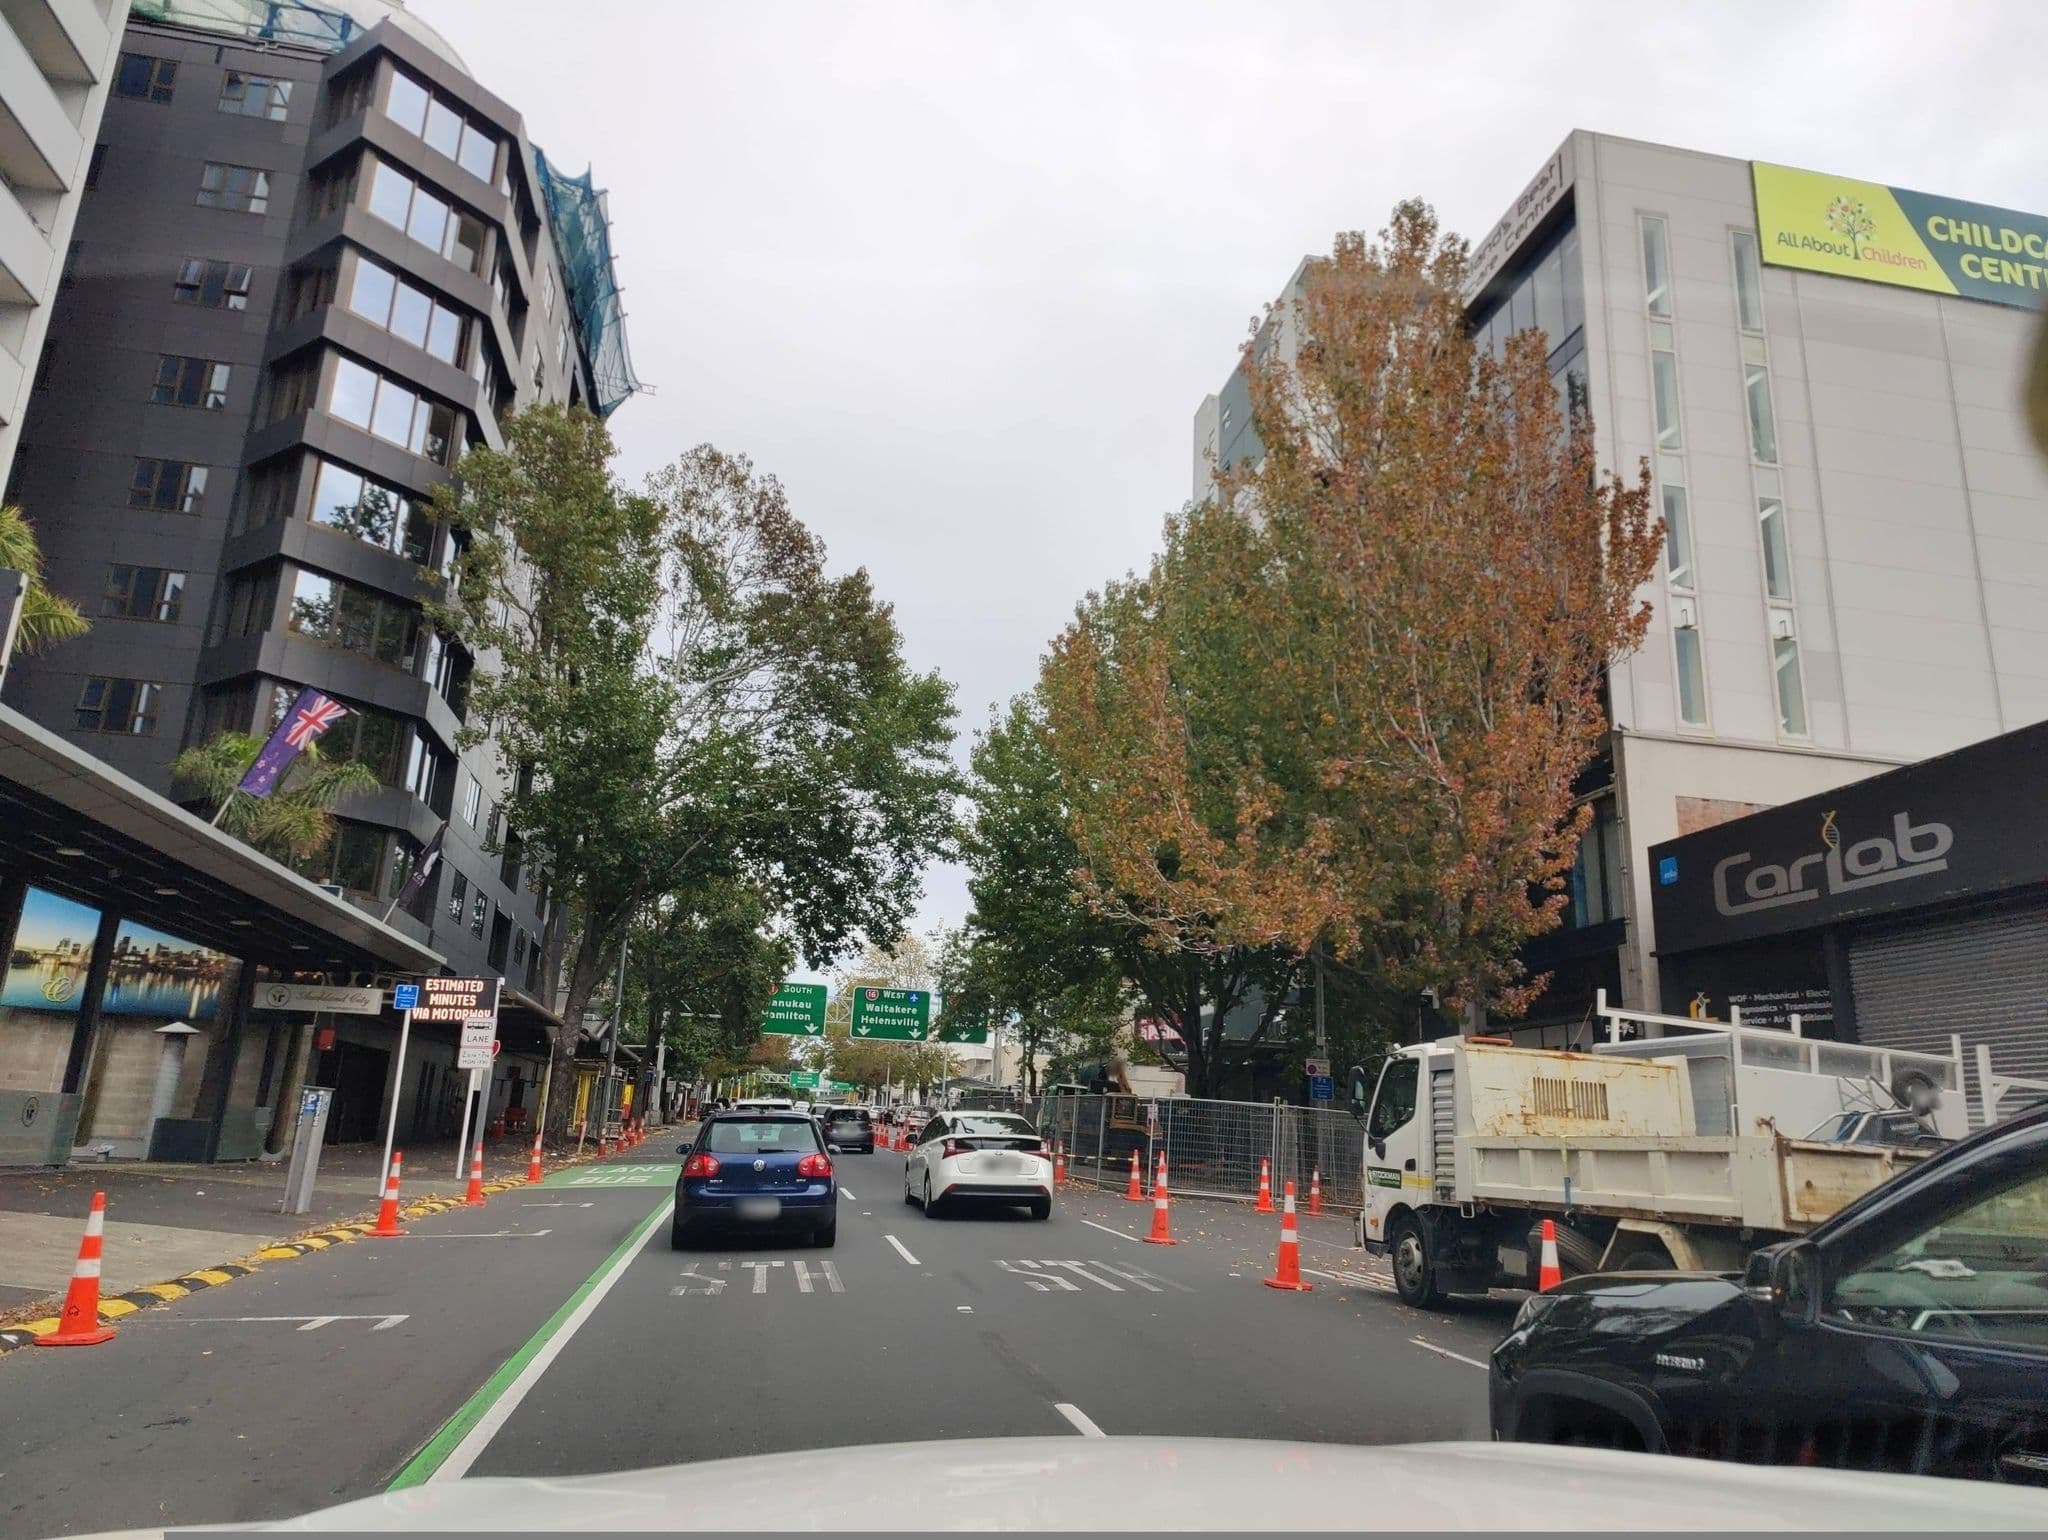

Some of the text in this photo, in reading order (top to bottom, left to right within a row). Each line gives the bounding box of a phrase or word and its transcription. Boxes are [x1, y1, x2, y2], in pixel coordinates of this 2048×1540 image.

[1504, 185, 1556, 252] Centre
[1777, 231, 1928, 270] All About Children
[425, 979, 484, 992] ESTIMATED
[429, 993, 477, 1006] MINUTES
[883, 990, 906, 999] WEST
[1728, 995, 1747, 1003] WOF
[1753, 991, 1799, 1002] Mechanical
[767, 1000, 812, 1009] anukau
[866, 1003, 917, 1015] Waitakere
[1739, 1004, 1778, 1015] agnostics
[412, 1007, 430, 1020] VIA
[861, 1015, 920, 1027] Helensville
[1740, 1016, 1767, 1025] ervice
[1773, 1015, 1785, 1023] Air
[467, 1035, 489, 1043] LANE
[583, 1164, 676, 1174] LANE
[567, 1175, 652, 1185] BUS
[669, 1259, 847, 1296] STH
